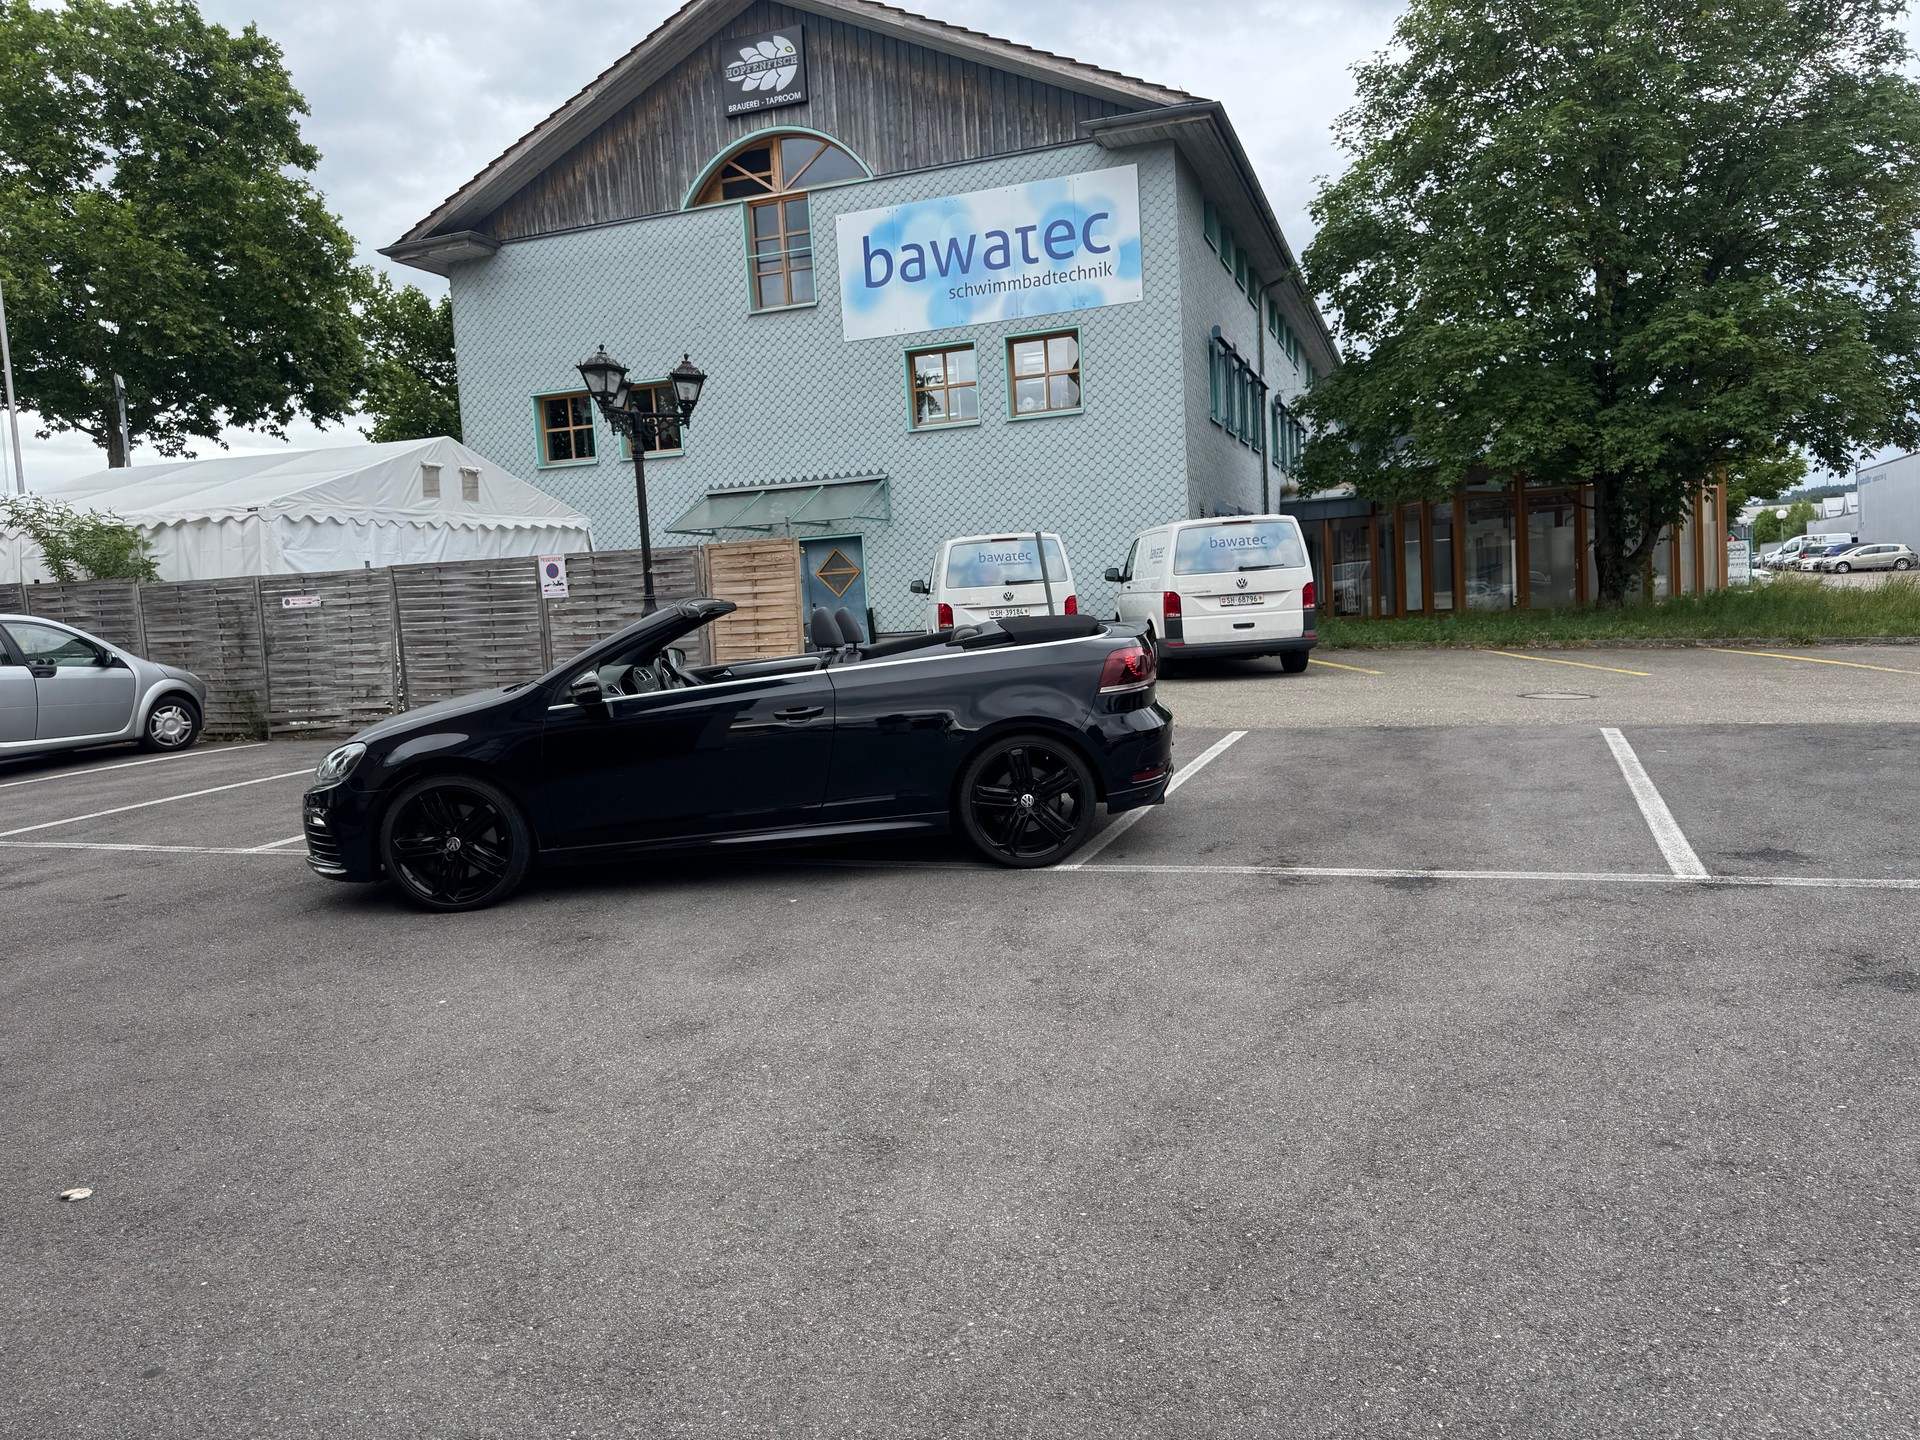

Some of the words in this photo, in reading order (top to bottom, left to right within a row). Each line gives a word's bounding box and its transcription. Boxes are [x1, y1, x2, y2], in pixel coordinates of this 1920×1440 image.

[725, 55, 798, 78] HOPFENFISCH
[728, 100, 760, 113] BRAUEREI
[766, 91, 802, 105] TAPROOM
[863, 212, 1111, 289] bawatec
[949, 262, 1112, 300] schwimmbadtechnik
[1209, 534, 1268, 549] bawatec
[979, 552, 1032, 563] bawatec
